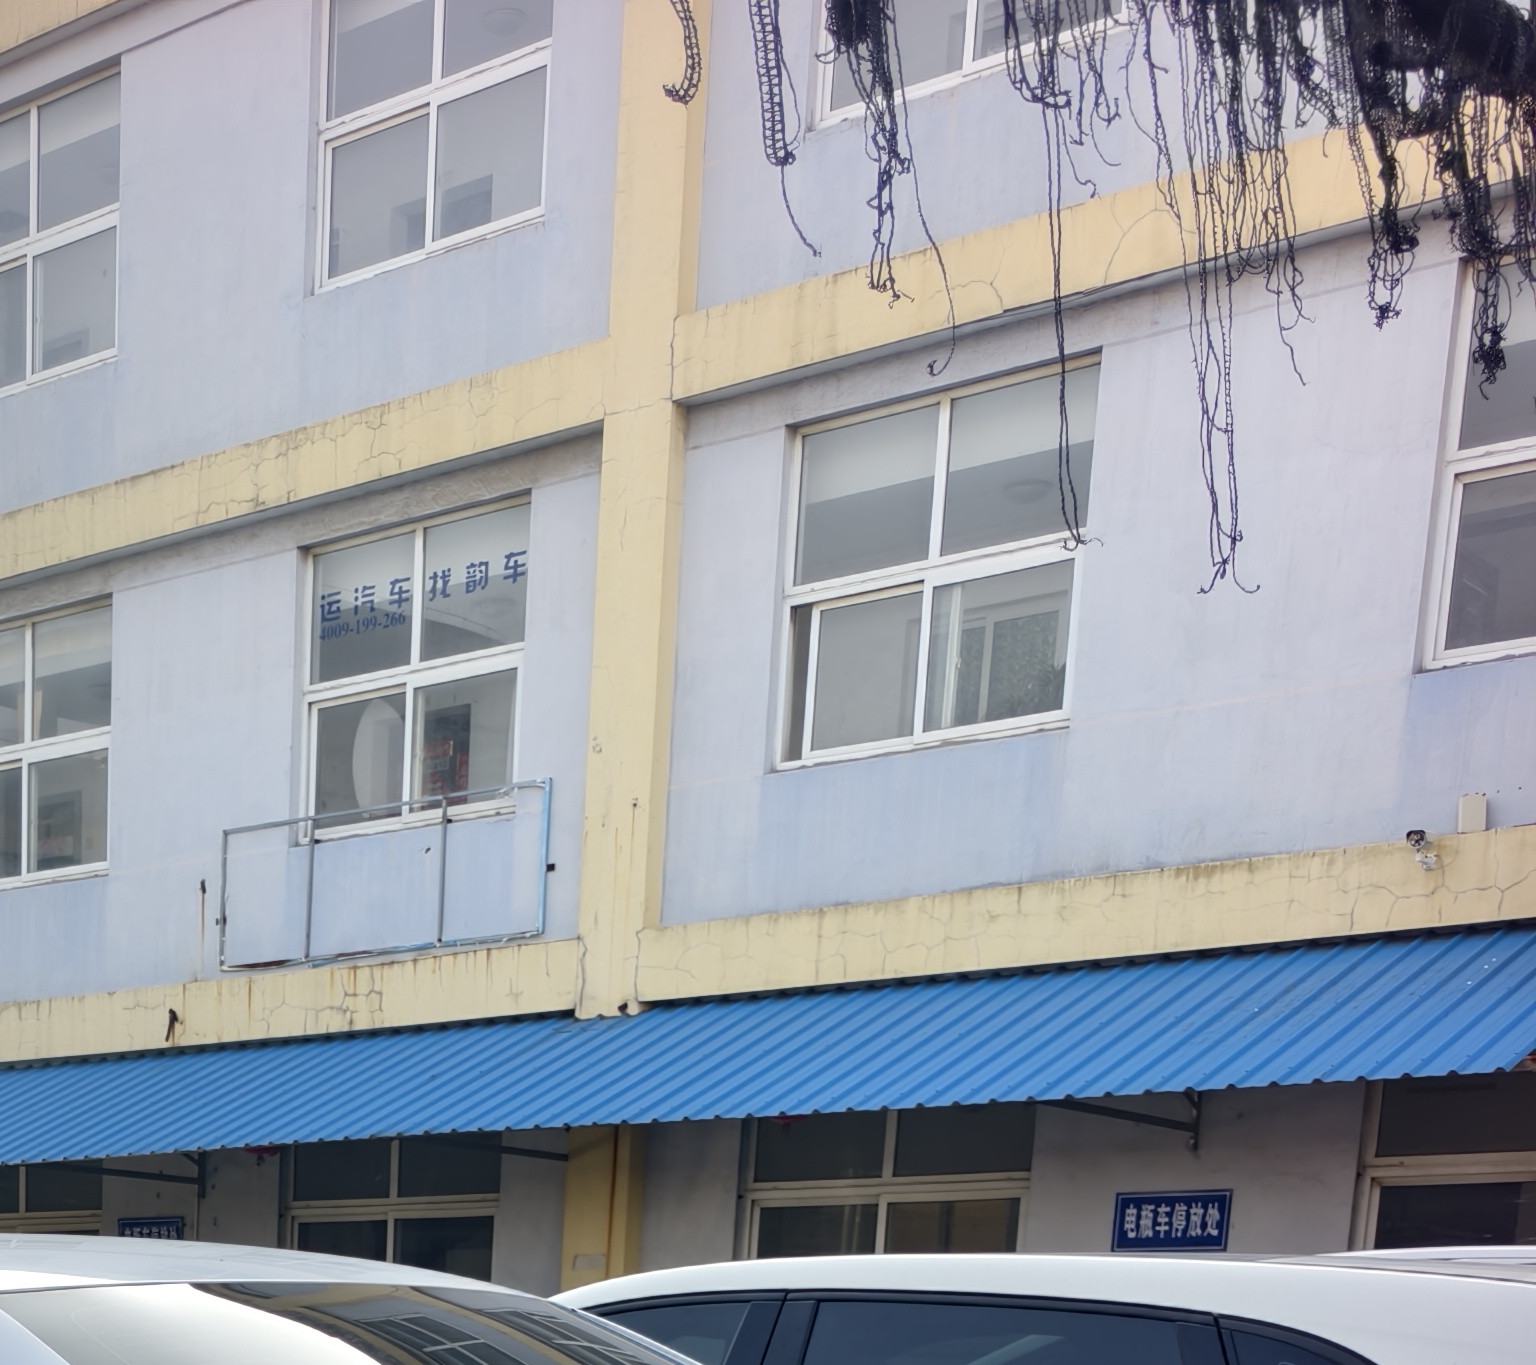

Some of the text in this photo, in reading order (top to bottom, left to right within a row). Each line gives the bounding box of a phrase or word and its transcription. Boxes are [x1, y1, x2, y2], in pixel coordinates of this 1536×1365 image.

[320, 551, 527, 623] 运汽车找韵车
[320, 611, 406, 641] 4009-199-266
[1124, 1201, 1220, 1239] 电瓶车停放处
